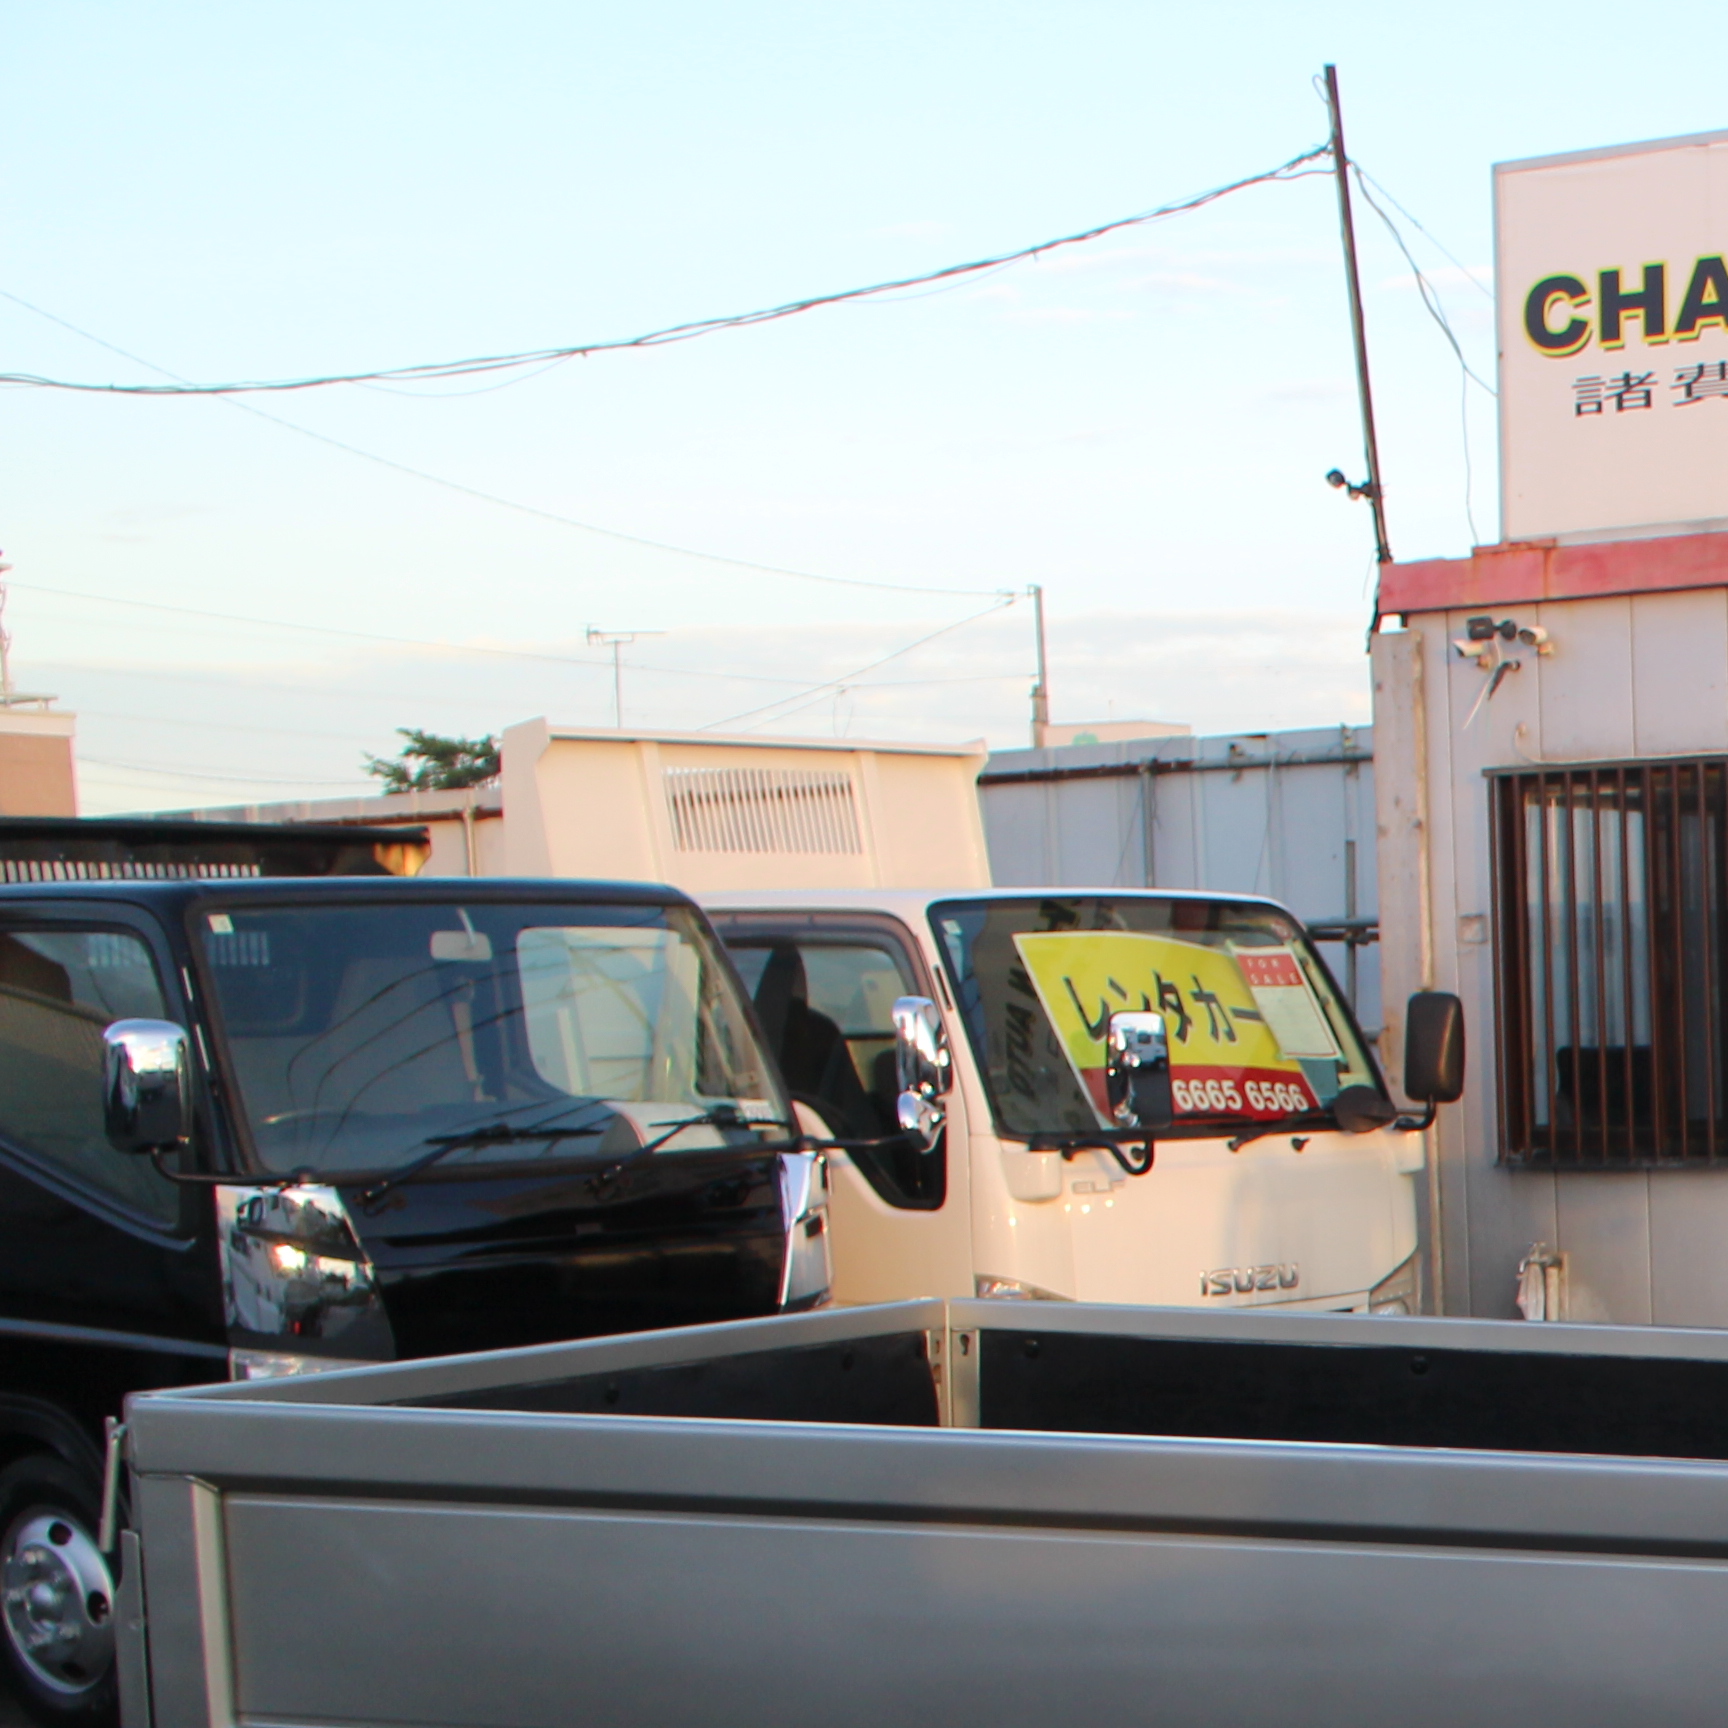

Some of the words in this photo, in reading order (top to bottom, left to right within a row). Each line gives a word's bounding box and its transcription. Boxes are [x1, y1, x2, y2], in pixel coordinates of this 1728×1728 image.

[1246, 957, 1281, 970] FOR
[1249, 972, 1300, 985] SALE
[1171, 1078, 1243, 1111] 6665
[1244, 1079, 1309, 1113] 6566
[1200, 1261, 1299, 1298] ISUZU
